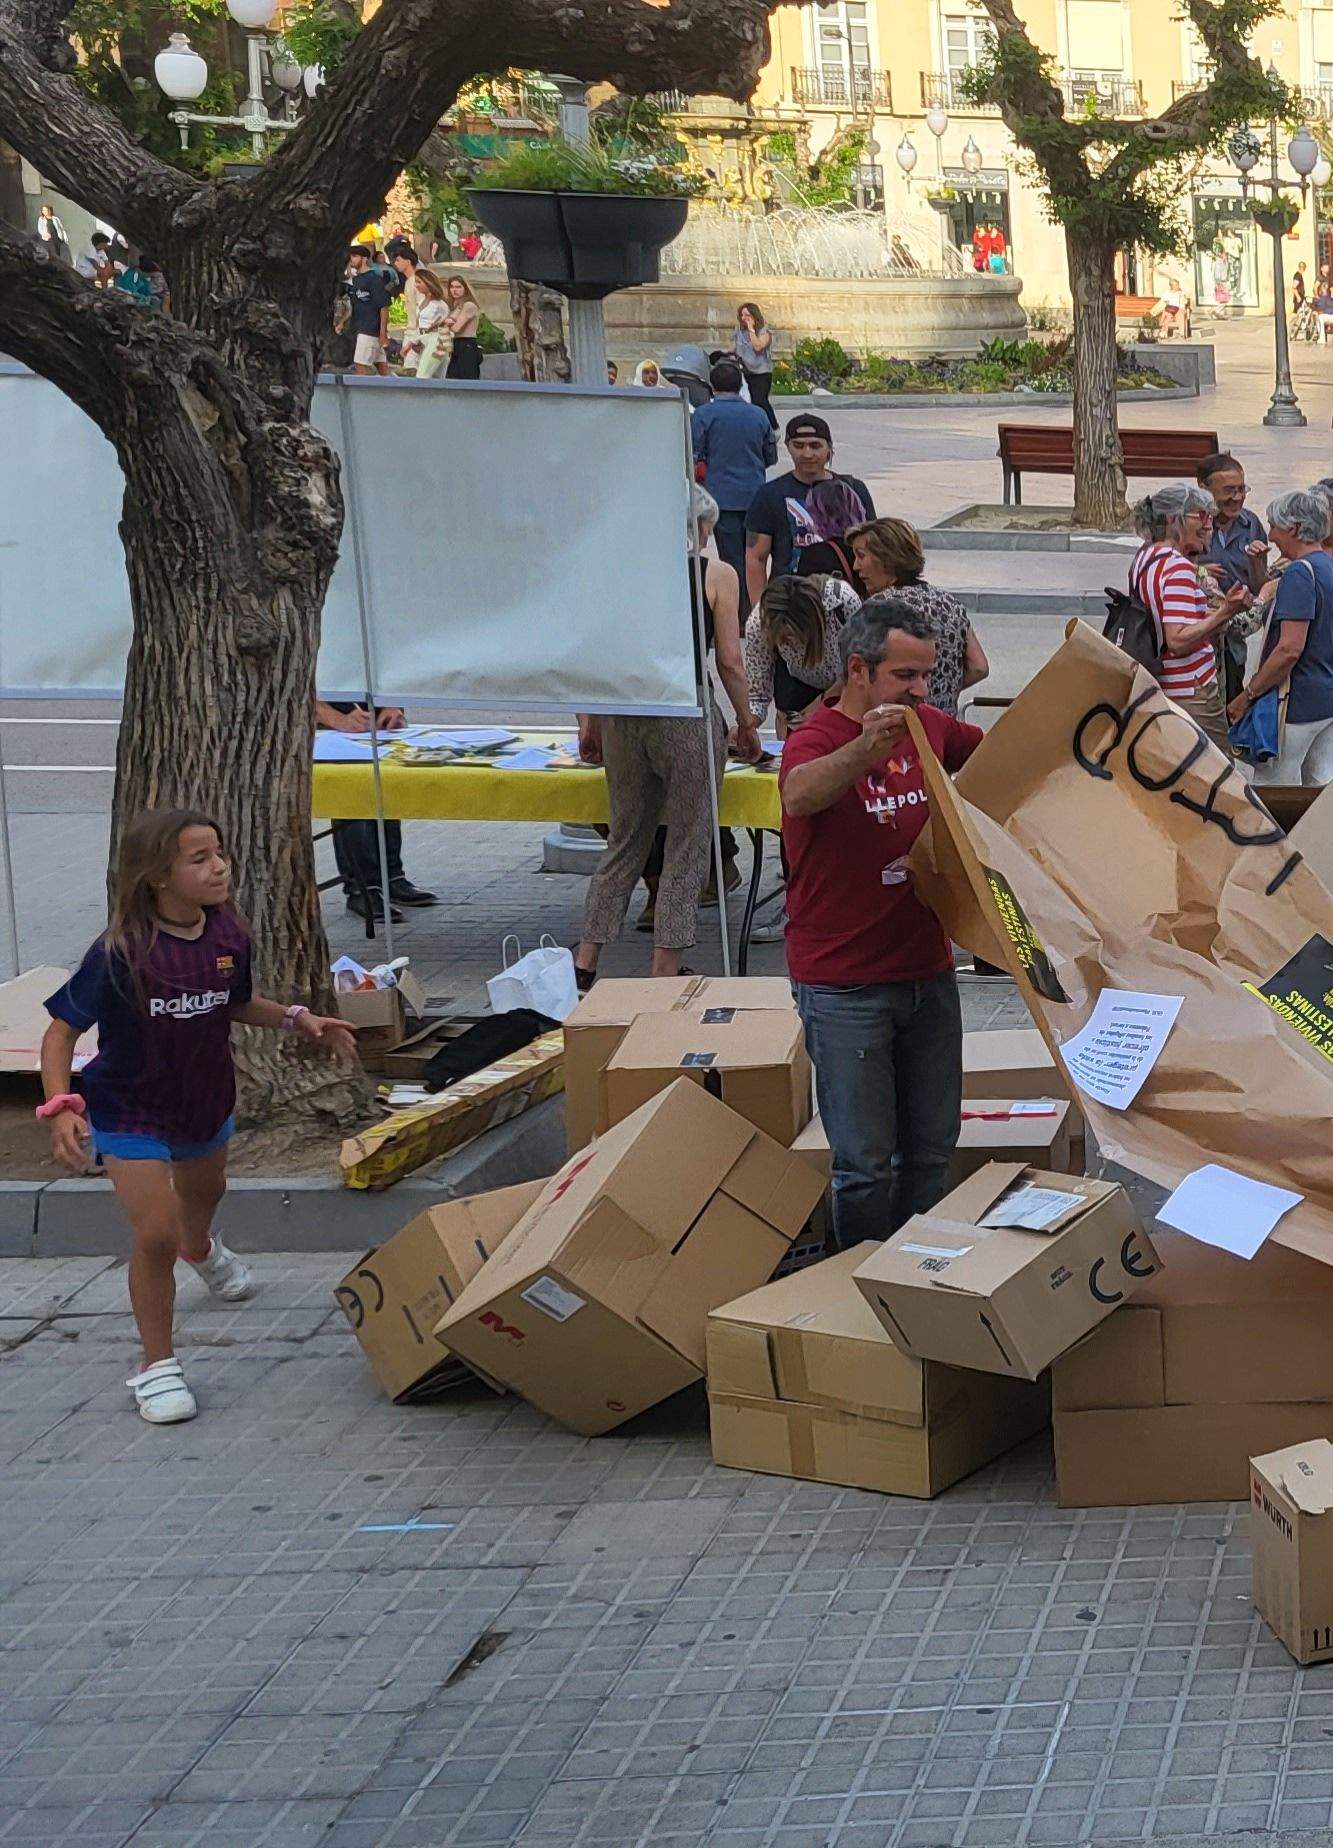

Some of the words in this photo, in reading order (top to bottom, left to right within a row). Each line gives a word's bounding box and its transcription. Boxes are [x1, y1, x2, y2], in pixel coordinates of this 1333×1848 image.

[1269, 994, 1323, 1047] VIVIENDAS
[1088, 1230, 1156, 1305] CE
[1260, 1496, 1294, 1543] WÜRTH
